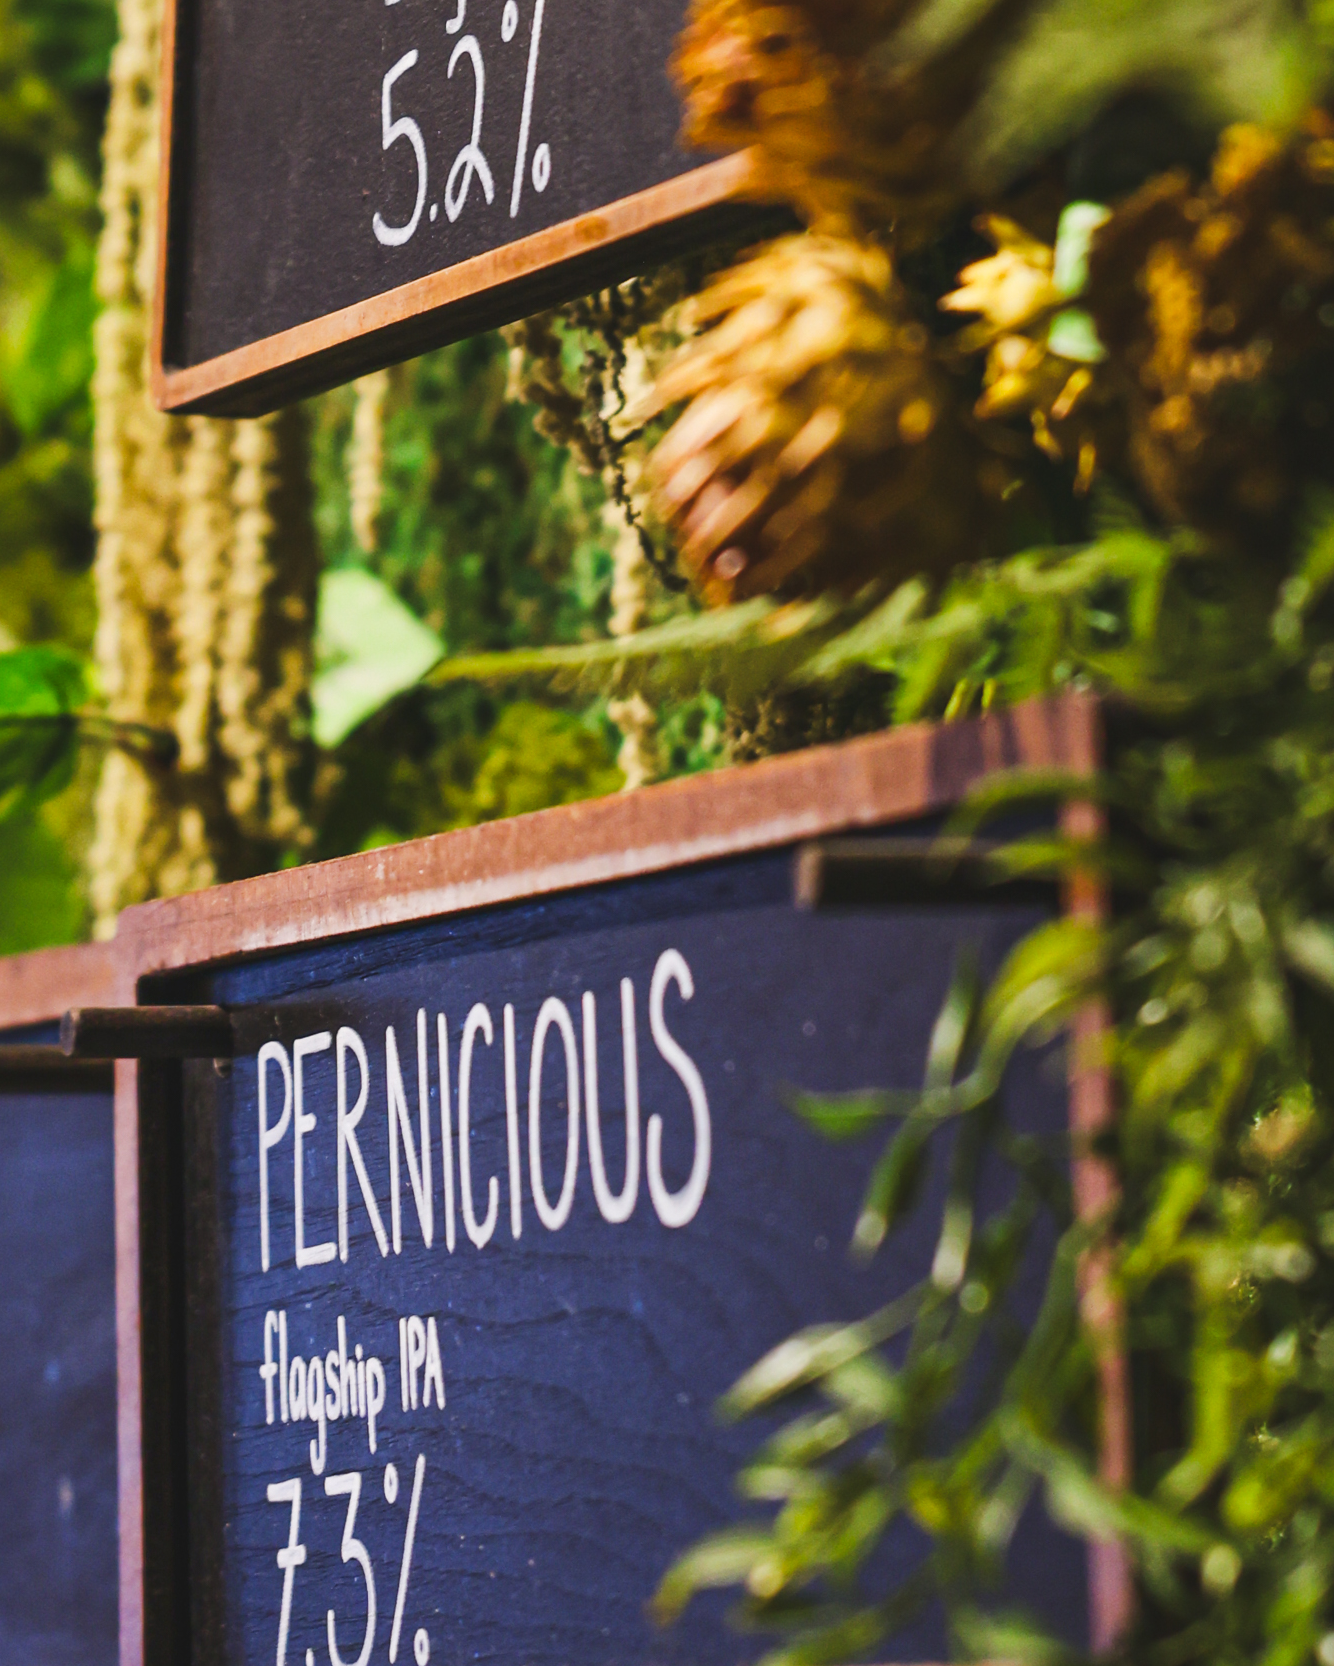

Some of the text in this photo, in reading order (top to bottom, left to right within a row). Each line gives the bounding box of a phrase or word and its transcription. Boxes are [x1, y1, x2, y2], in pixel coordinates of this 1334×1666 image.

[257, 948, 712, 1273] PERNICIOUS
[259, 1310, 446, 1475] flagship IPA
